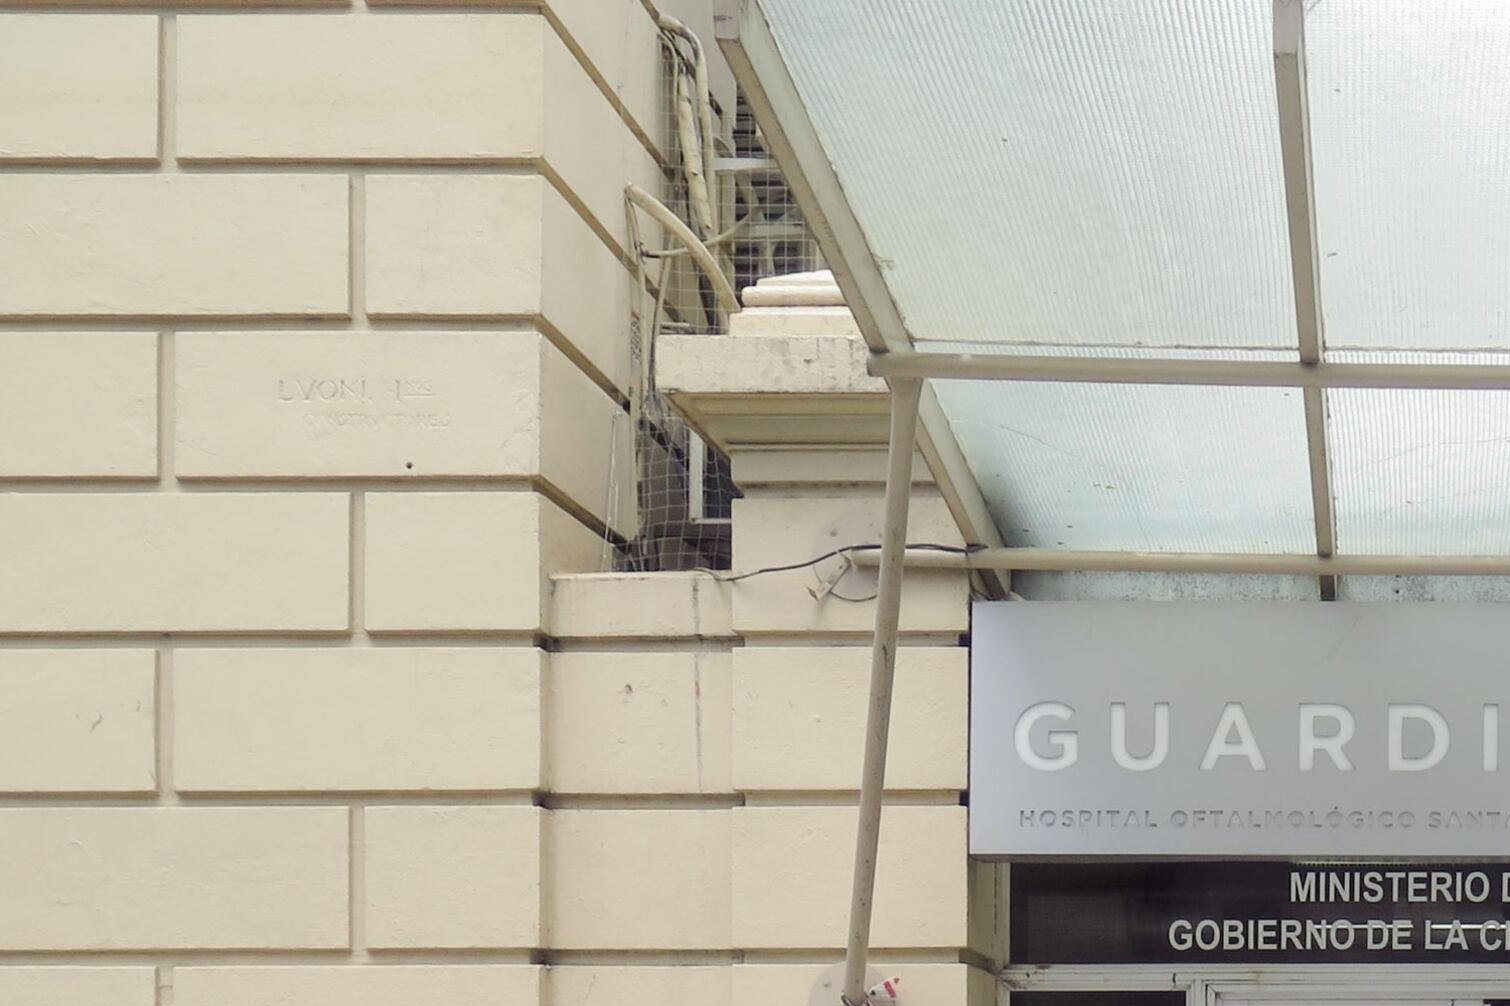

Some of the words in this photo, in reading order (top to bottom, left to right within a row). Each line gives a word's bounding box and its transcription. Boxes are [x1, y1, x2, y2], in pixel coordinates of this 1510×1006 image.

[1019, 810, 1158, 829] HOSPITAL
[1170, 806, 1416, 829] OFTALMOLÓGICO
[1289, 871, 1491, 903] MINISTERIO
[1168, 919, 1355, 950] GOBIERNO
[1366, 919, 1413, 950] DE
[1424, 919, 1469, 950] LA
